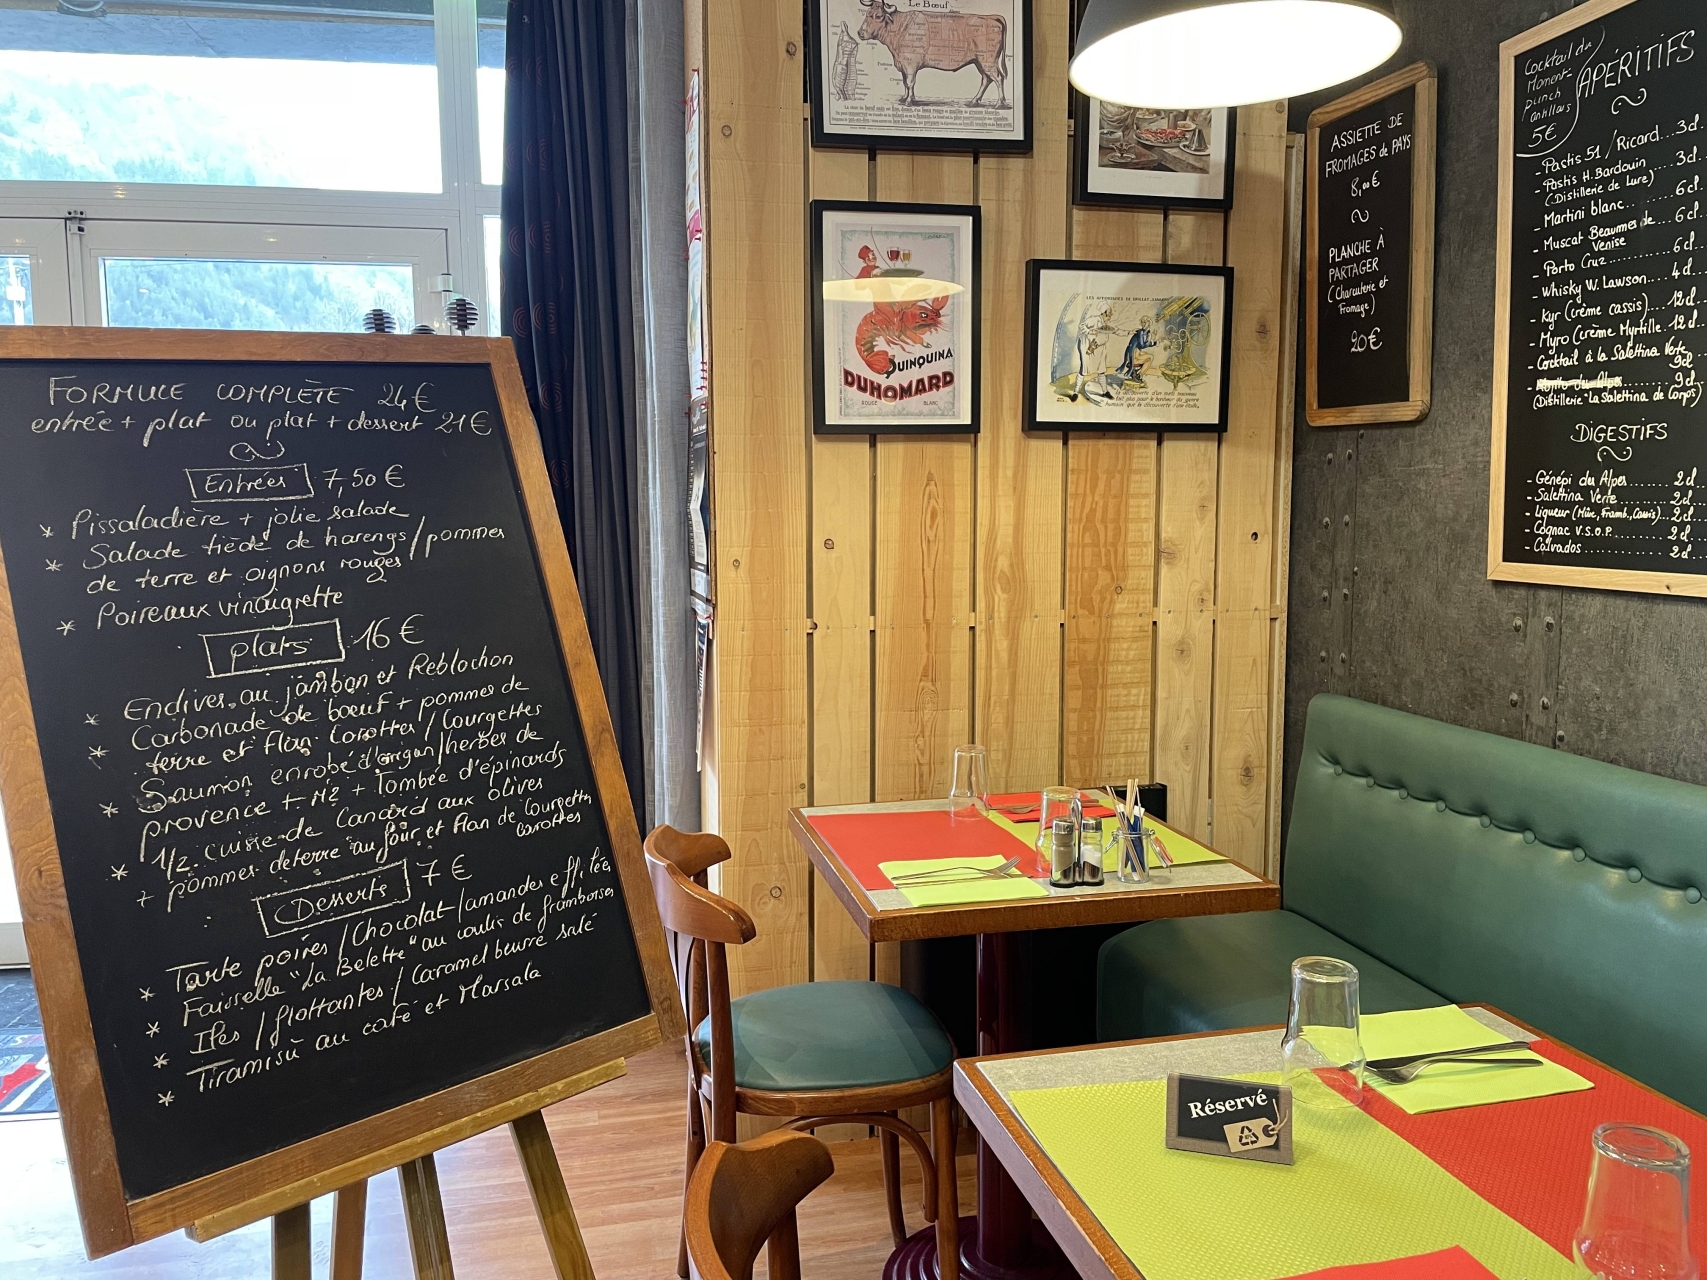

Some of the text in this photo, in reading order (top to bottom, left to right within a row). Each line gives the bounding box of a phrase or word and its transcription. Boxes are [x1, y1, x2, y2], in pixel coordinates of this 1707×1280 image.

[1525, 37, 1592, 76] Cocktail du
[1578, 30, 1695, 98] APÉRITIFS
[1522, 88, 1561, 122] punch
[1331, 113, 1403, 152] ASSIETTE DE
[1528, 123, 1557, 147] 5€
[1326, 134, 1411, 178] FROMAGES de PAYS
[1542, 145, 1601, 173] Pastis 51
[1543, 175, 1577, 192] Pastis
[1608, 180, 1620, 192] de
[1626, 170, 1654, 187] Lure)
[1544, 199, 1625, 228] Martini blanc
[1544, 210, 1655, 250] Muscat Beaumes de
[1329, 227, 1384, 263] PLANCHE À
[1592, 237, 1627, 251] Venise
[1329, 257, 1379, 283] PARTAGER
[1379, 275, 1388, 288] et
[1544, 253, 1607, 276] Porto Cruz
[1542, 274, 1647, 303] Whisky W. Lawson
[1540, 333, 1569, 355] Myro
[1620, 318, 1662, 346] Myrtille
[1542, 308, 1561, 330] Kyr
[885, 347, 953, 379] QUINQUINA
[1537, 336, 1688, 370] Cocktail à la Salettina Verte
[50, 376, 188, 405] FORMULE
[217, 379, 354, 404] COMPLÈTE
[843, 367, 954, 403] DUHOMARD
[1653, 386, 1664, 401] de
[31, 410, 114, 433] entrée
[143, 409, 212, 447] plat
[231, 415, 257, 428] ou
[266, 410, 318, 440] plat
[348, 411, 423, 431] dessert
[1570, 418, 1667, 442] DIGESTIFS
[204, 471, 287, 494] Entrées
[1535, 469, 1627, 495] Génépi Alpes
[1535, 488, 1584, 502] Salettina
[72, 499, 409, 540] Pissaladière jolie salade
[1534, 521, 1570, 542] Cognac
[1535, 505, 1570, 525] Liqueur
[83, 531, 314, 569] Salade tiède de
[1534, 537, 1581, 554] Calvados
[87, 556, 401, 598] de terre et oignons rouges
[97, 585, 343, 630] Poireaux vinaigrette
[231, 633, 312, 673] plats
[124, 646, 513, 720] Endives au jambon et Reblochon
[132, 674, 529, 751] Carbonade de pommes de
[146, 752, 212, 774] terre
[223, 740, 253, 762] et
[443, 702, 542, 738] Courgettes
[138, 723, 543, 813] Saumon enrobé de
[140, 741, 566, 862] provence Tombée d'épinards
[286, 817, 323, 842] de
[337, 796, 428, 828] Canard
[437, 796, 474, 809] aux
[488, 776, 543, 800] olives
[168, 865, 254, 913] pommes
[353, 839, 375, 855] au
[376, 823, 421, 863] four
[426, 820, 445, 839] et
[498, 807, 515, 825] de
[274, 877, 387, 924] Desserts
[165, 901, 455, 992] Tarte poires Chocolat
[183, 977, 285, 1027] Faisselle
[422, 935, 447, 951] au
[457, 913, 504, 940] coulis
[513, 903, 531, 924] de
[538, 888, 614, 934] framboises
[270, 982, 383, 1049] flottantes
[412, 944, 487, 985] Caramel
[494, 935, 547, 959] beurre
[556, 913, 597, 941] salé
[316, 1033, 349, 1050] au
[362, 1000, 418, 1035] café
[425, 993, 449, 1014] et
[459, 960, 541, 1004] Marsala
[1188, 1089, 1268, 1118] Réservé
